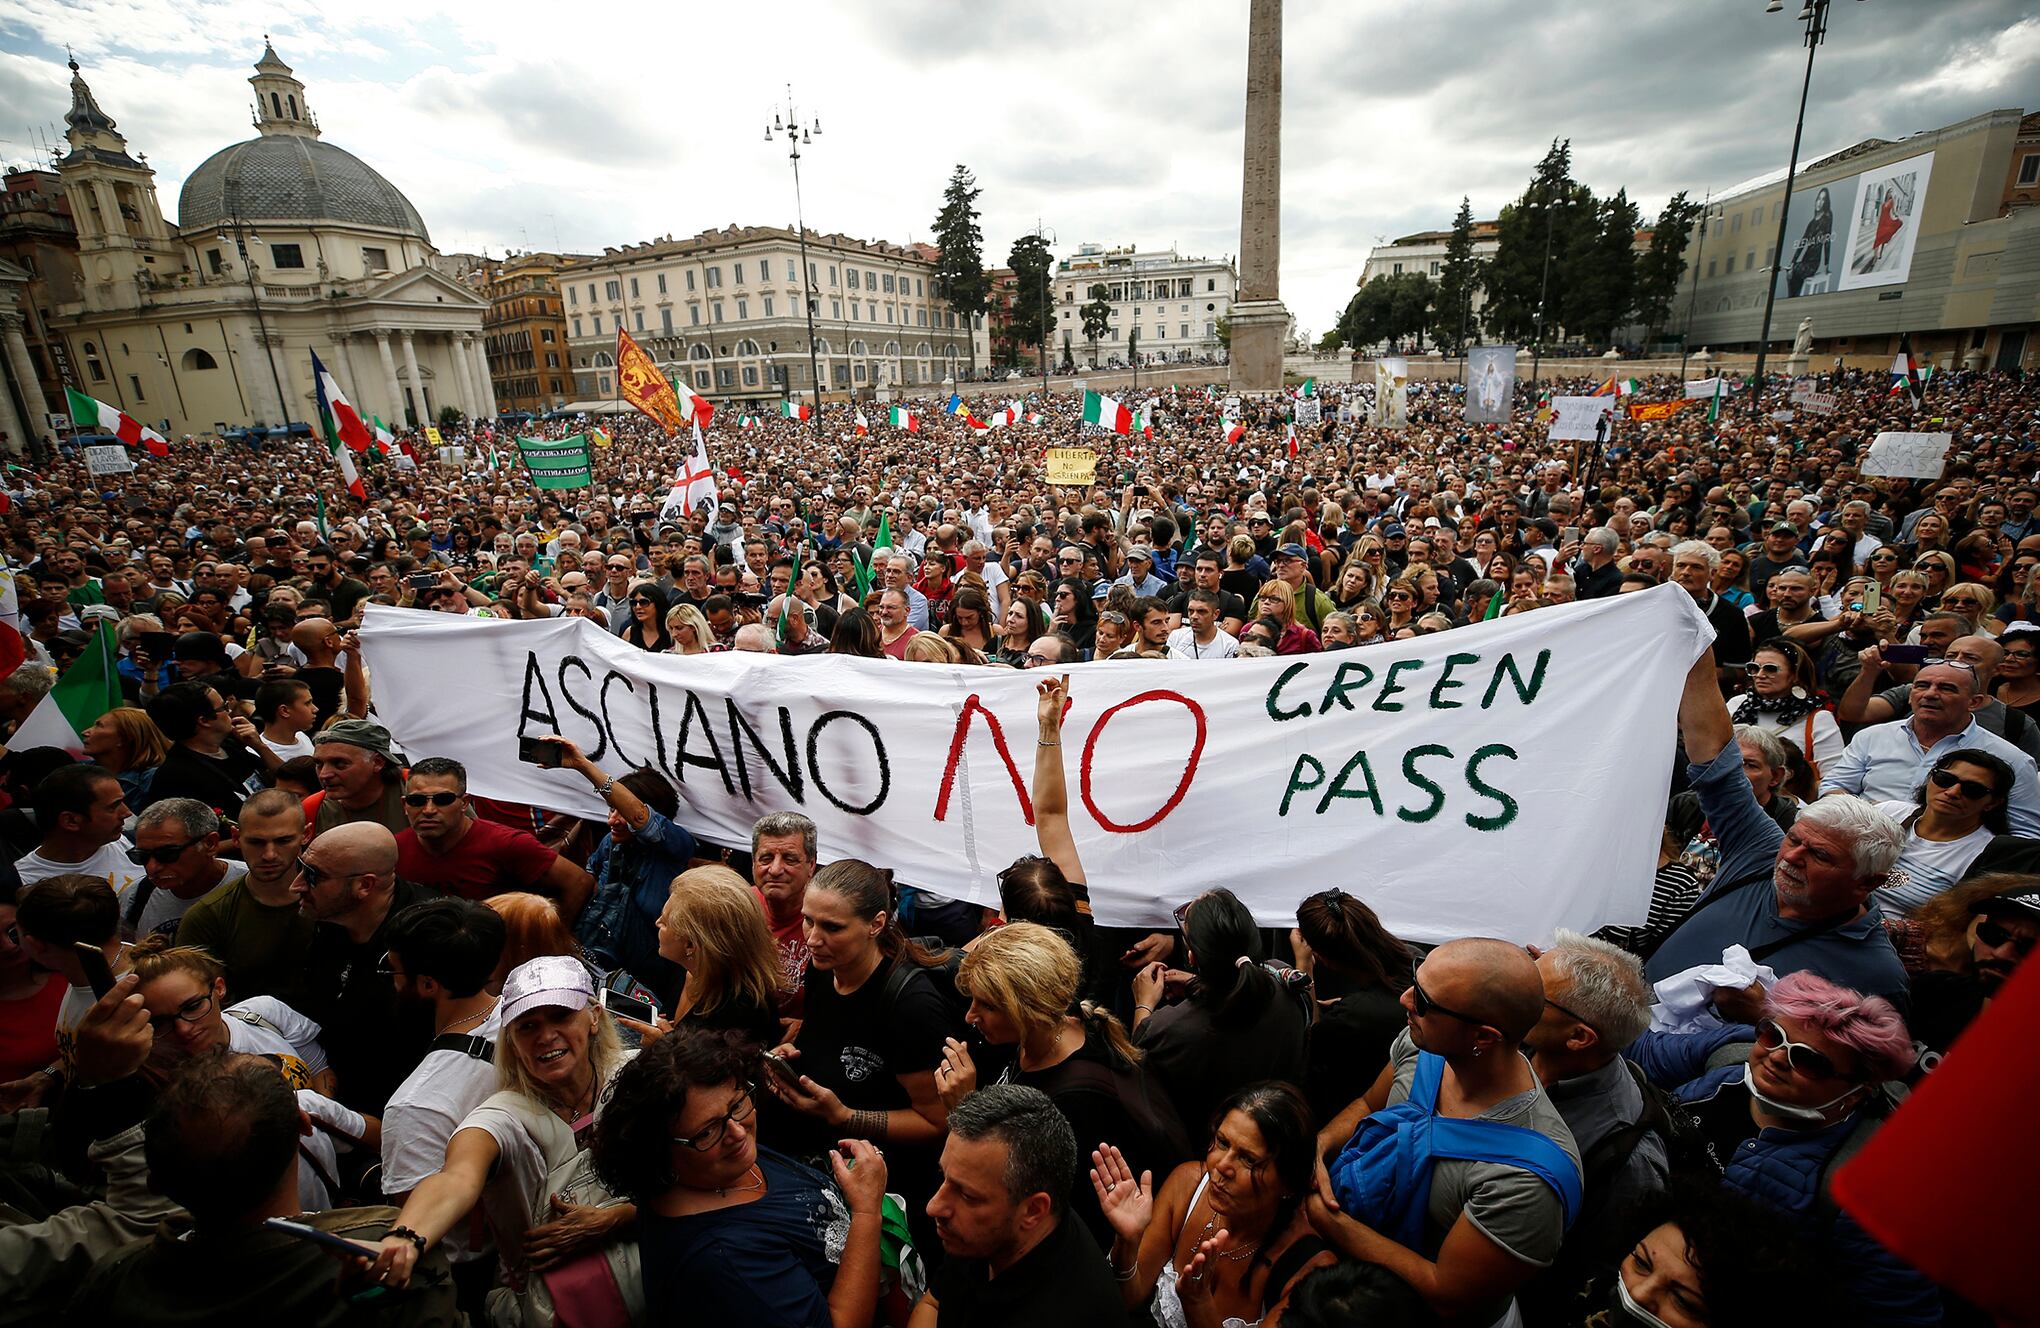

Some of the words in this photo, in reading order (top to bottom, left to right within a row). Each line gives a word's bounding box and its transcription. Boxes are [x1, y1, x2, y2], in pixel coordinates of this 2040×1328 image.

[1062, 462, 1074, 470] NO
[1886, 444, 1941, 459] NAZI
[1053, 471, 1079, 480] GREEN
[1266, 648, 1552, 722] GREEN
[517, 650, 890, 816] ASCIANO
[934, 690, 1208, 834] NO
[1278, 743, 1520, 832] PASS
